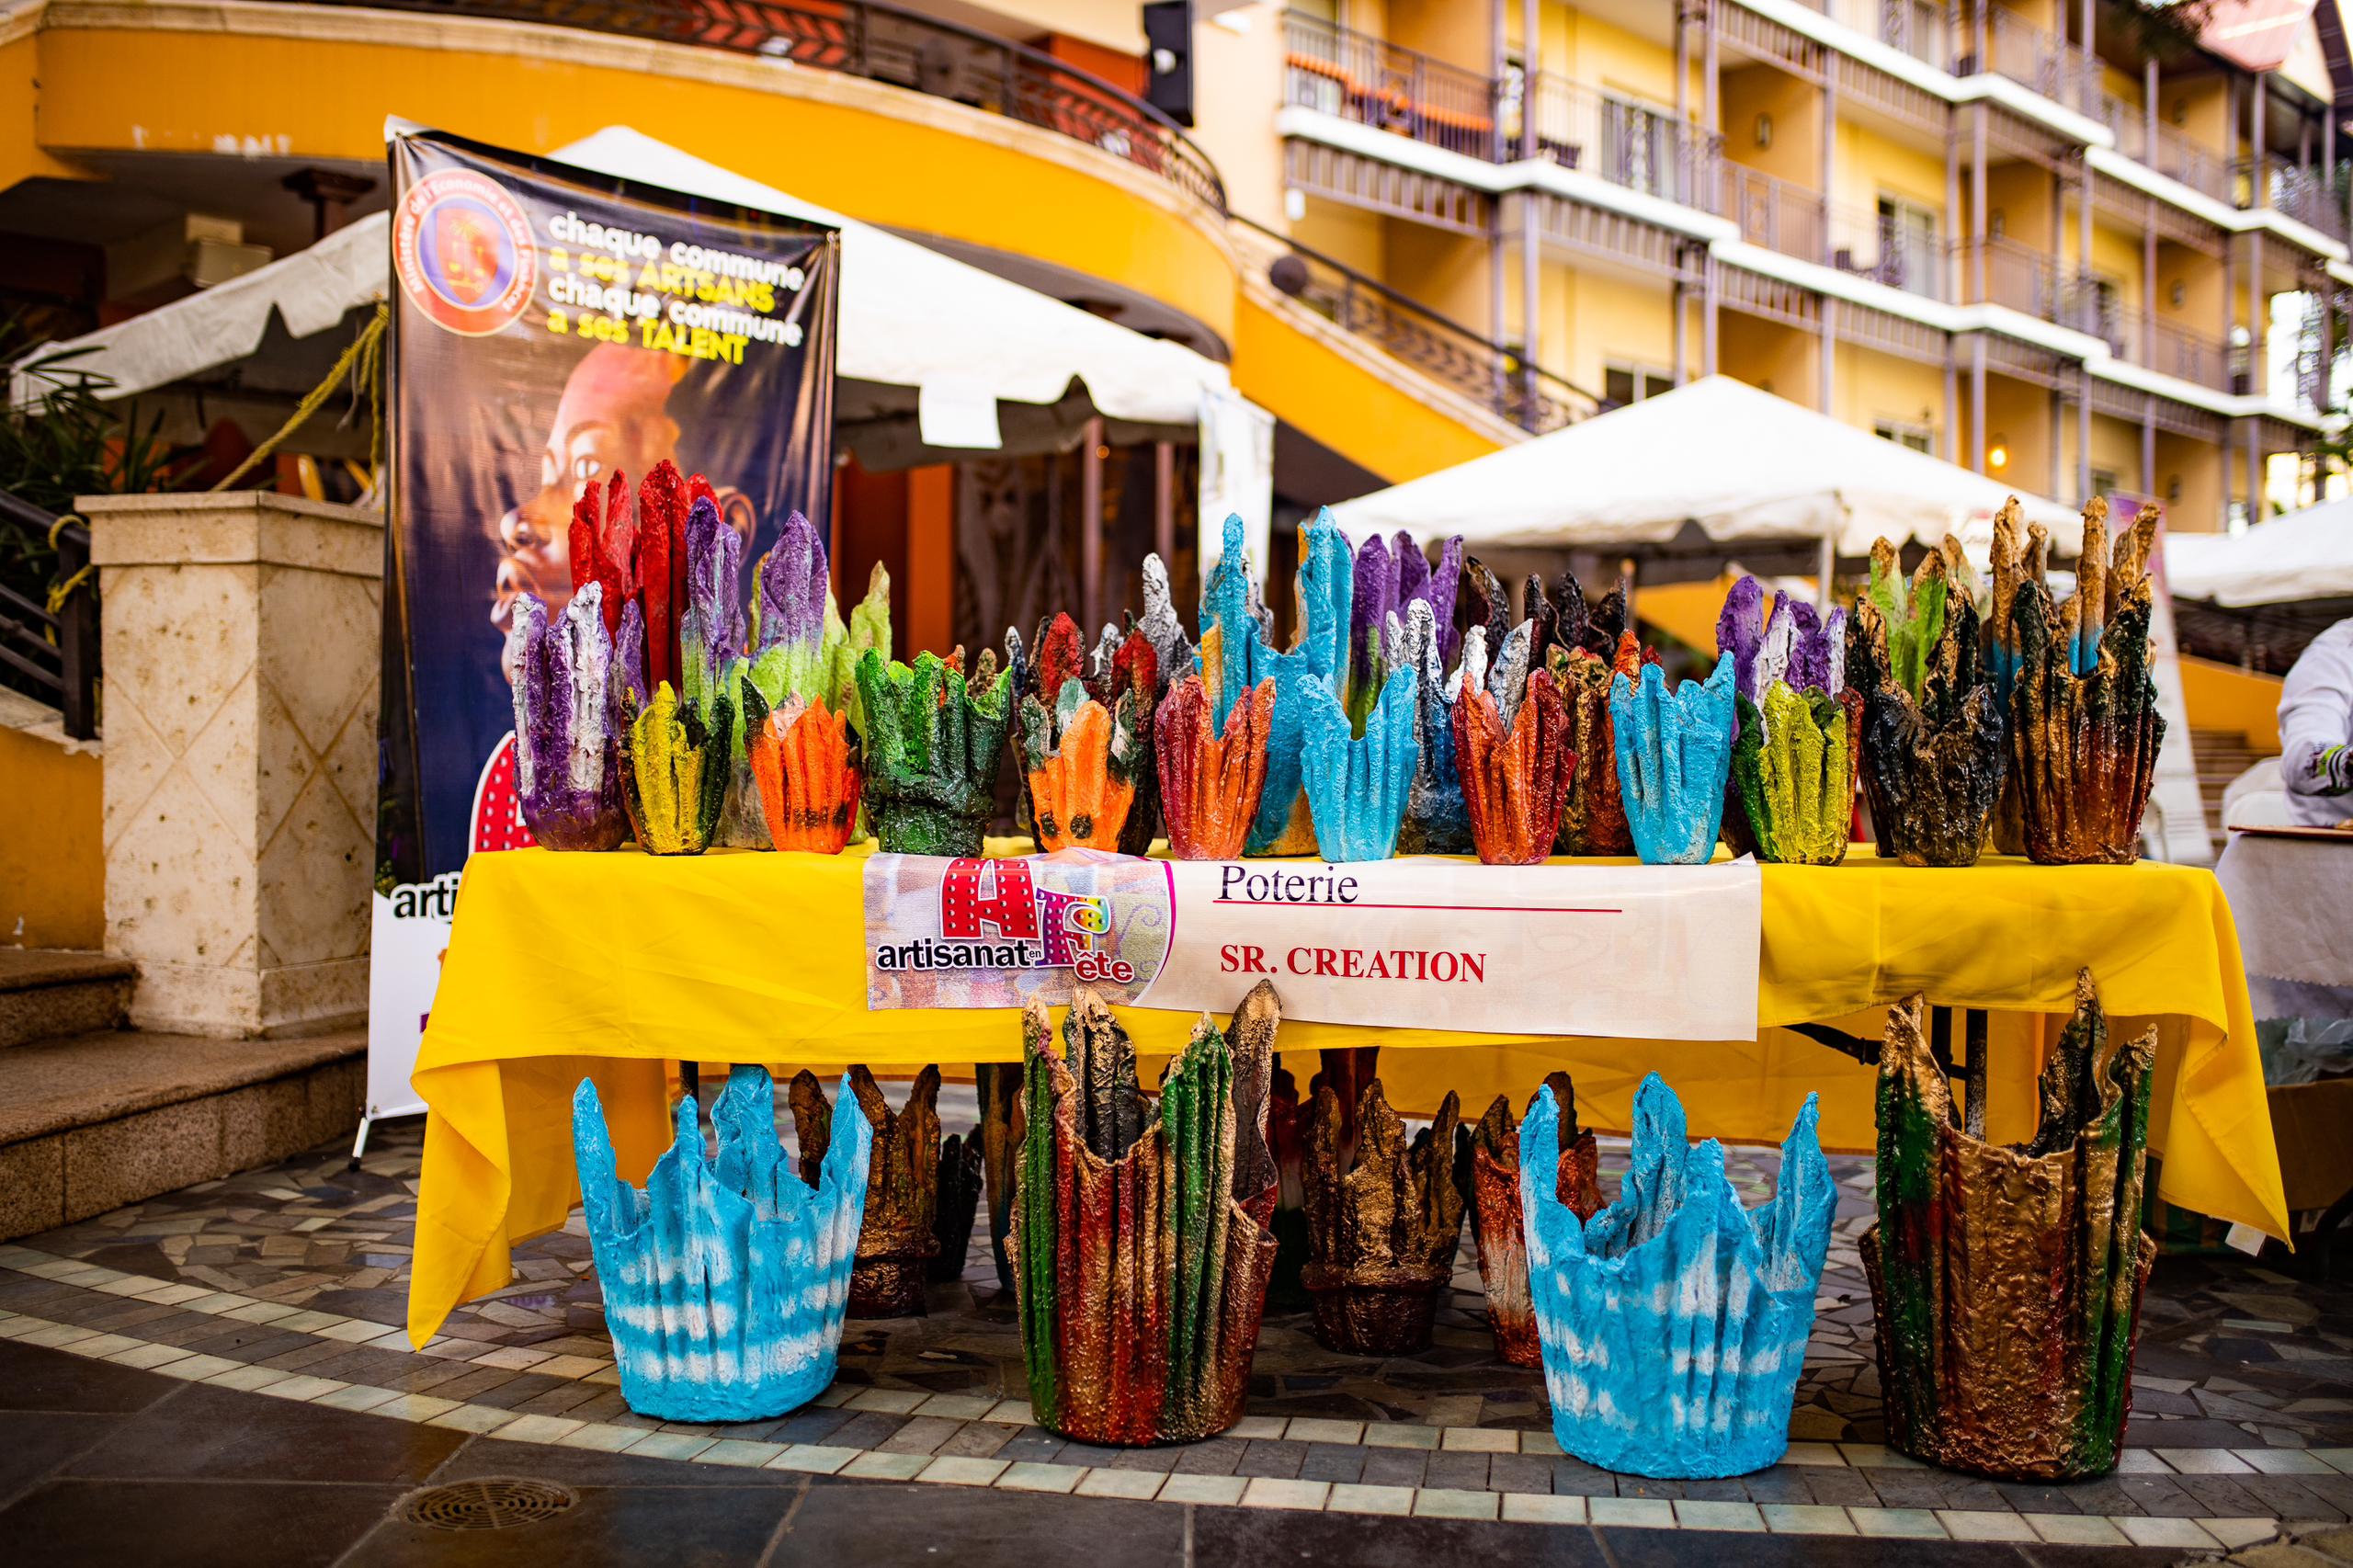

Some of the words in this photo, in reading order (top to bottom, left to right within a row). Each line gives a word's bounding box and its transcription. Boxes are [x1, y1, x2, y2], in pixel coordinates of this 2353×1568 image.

[549, 210, 662, 261] chaque
[670, 241, 805, 291] commune
[549, 246, 569, 271] a
[579, 252, 631, 284] ses
[548, 273, 662, 320] chaque
[668, 301, 803, 347] commune
[547, 308, 568, 334] a
[576, 313, 630, 344] ses
[638, 318, 749, 365] TALENT
[1218, 865, 1358, 903] Poterie
[878, 939, 1031, 968] artisanat
[1029, 949, 1041, 958] en
[1220, 944, 1278, 973] SR.
[1287, 947, 1487, 983] CREATION
